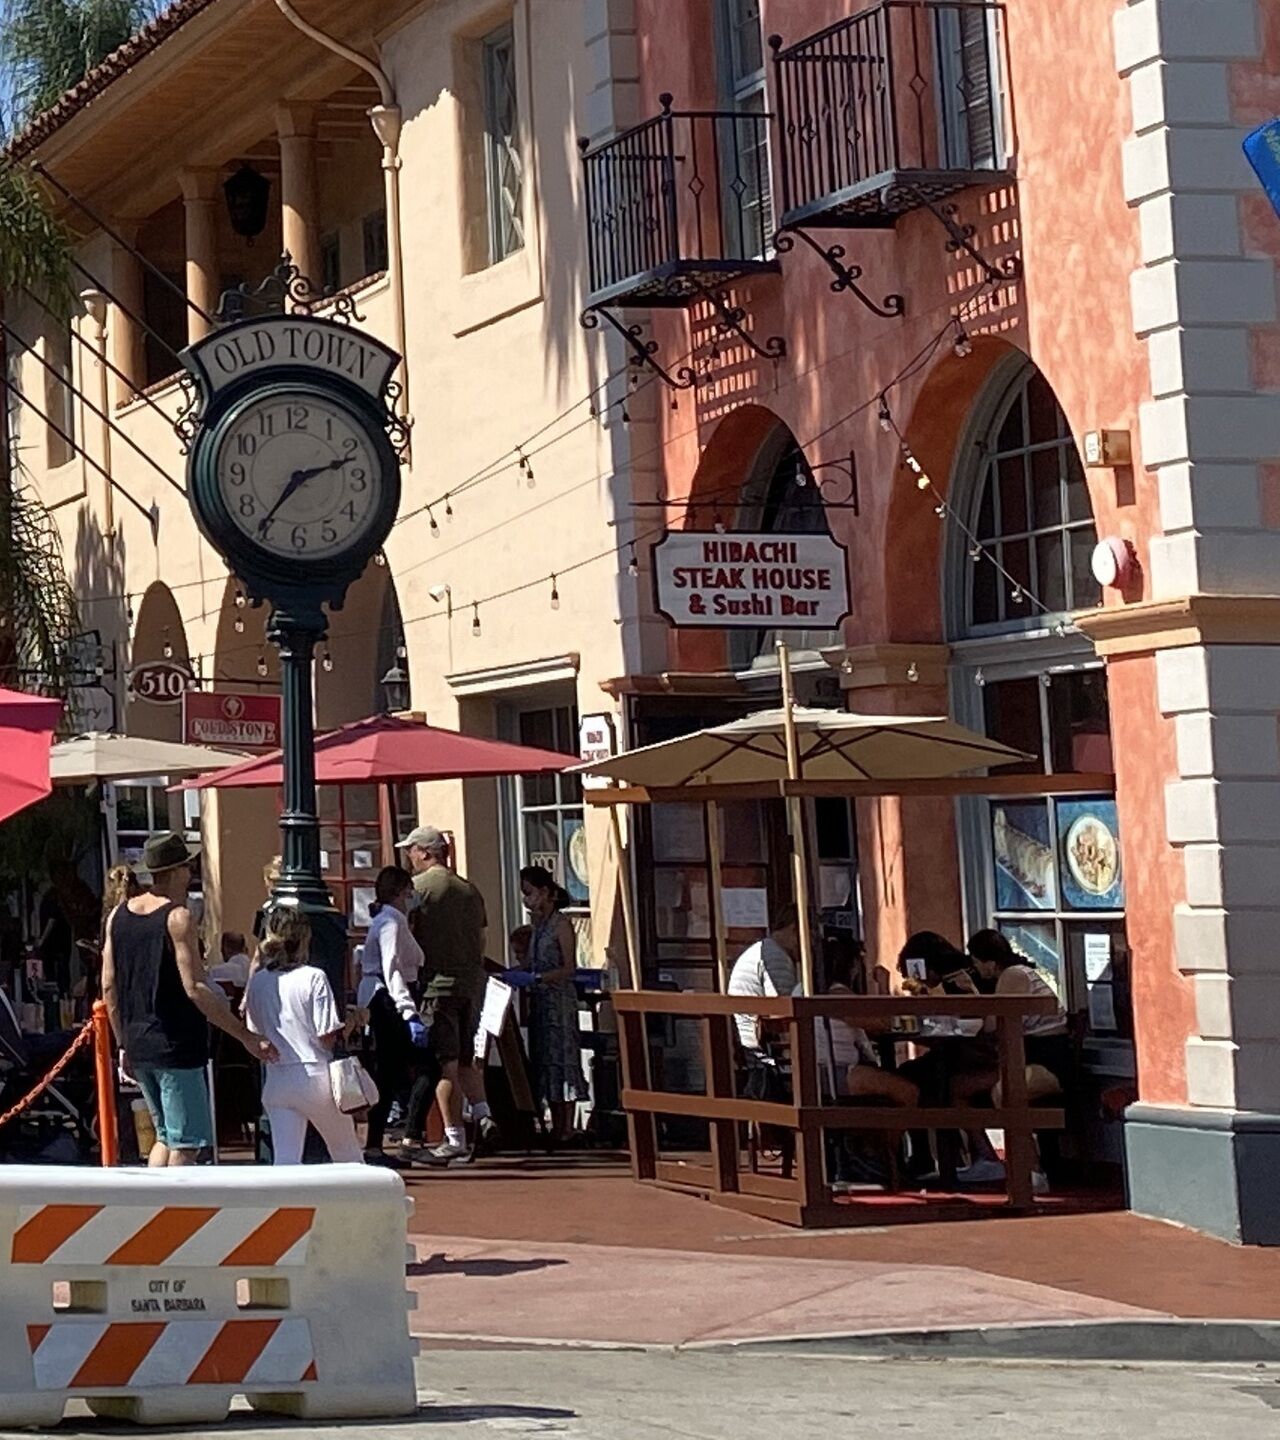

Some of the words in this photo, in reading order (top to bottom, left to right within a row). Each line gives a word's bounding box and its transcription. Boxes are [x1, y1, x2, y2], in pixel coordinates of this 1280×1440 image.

[214, 329, 275, 374] OLD
[283, 327, 376, 379] TOWN
[259, 411, 273, 436] 11
[286, 407, 309, 430] 12
[326, 418, 333, 440] 1
[237, 433, 256, 456] 10
[343, 438, 358, 461] 2
[230, 463, 245, 486] 9
[350, 468, 366, 492] 3
[239, 494, 255, 517] 8
[340, 500, 358, 522] 4
[291, 526, 307, 548] 6
[321, 519, 337, 543] 5
[702, 541, 798, 563] HIBACHI
[672, 567, 746, 589] STEAK
[752, 568, 831, 590] HOUSE
[689, 593, 707, 615] &
[712, 592, 773, 615] Sushi
[780, 594, 820, 616] Bar
[140, 671, 184, 696] 510
[192, 720, 225, 736] COLD
[230, 722, 274, 740] STONE
[149, 1280, 169, 1293] CITY
[173, 1280, 186, 1293] OF
[131, 1299, 161, 1312] SANTA
